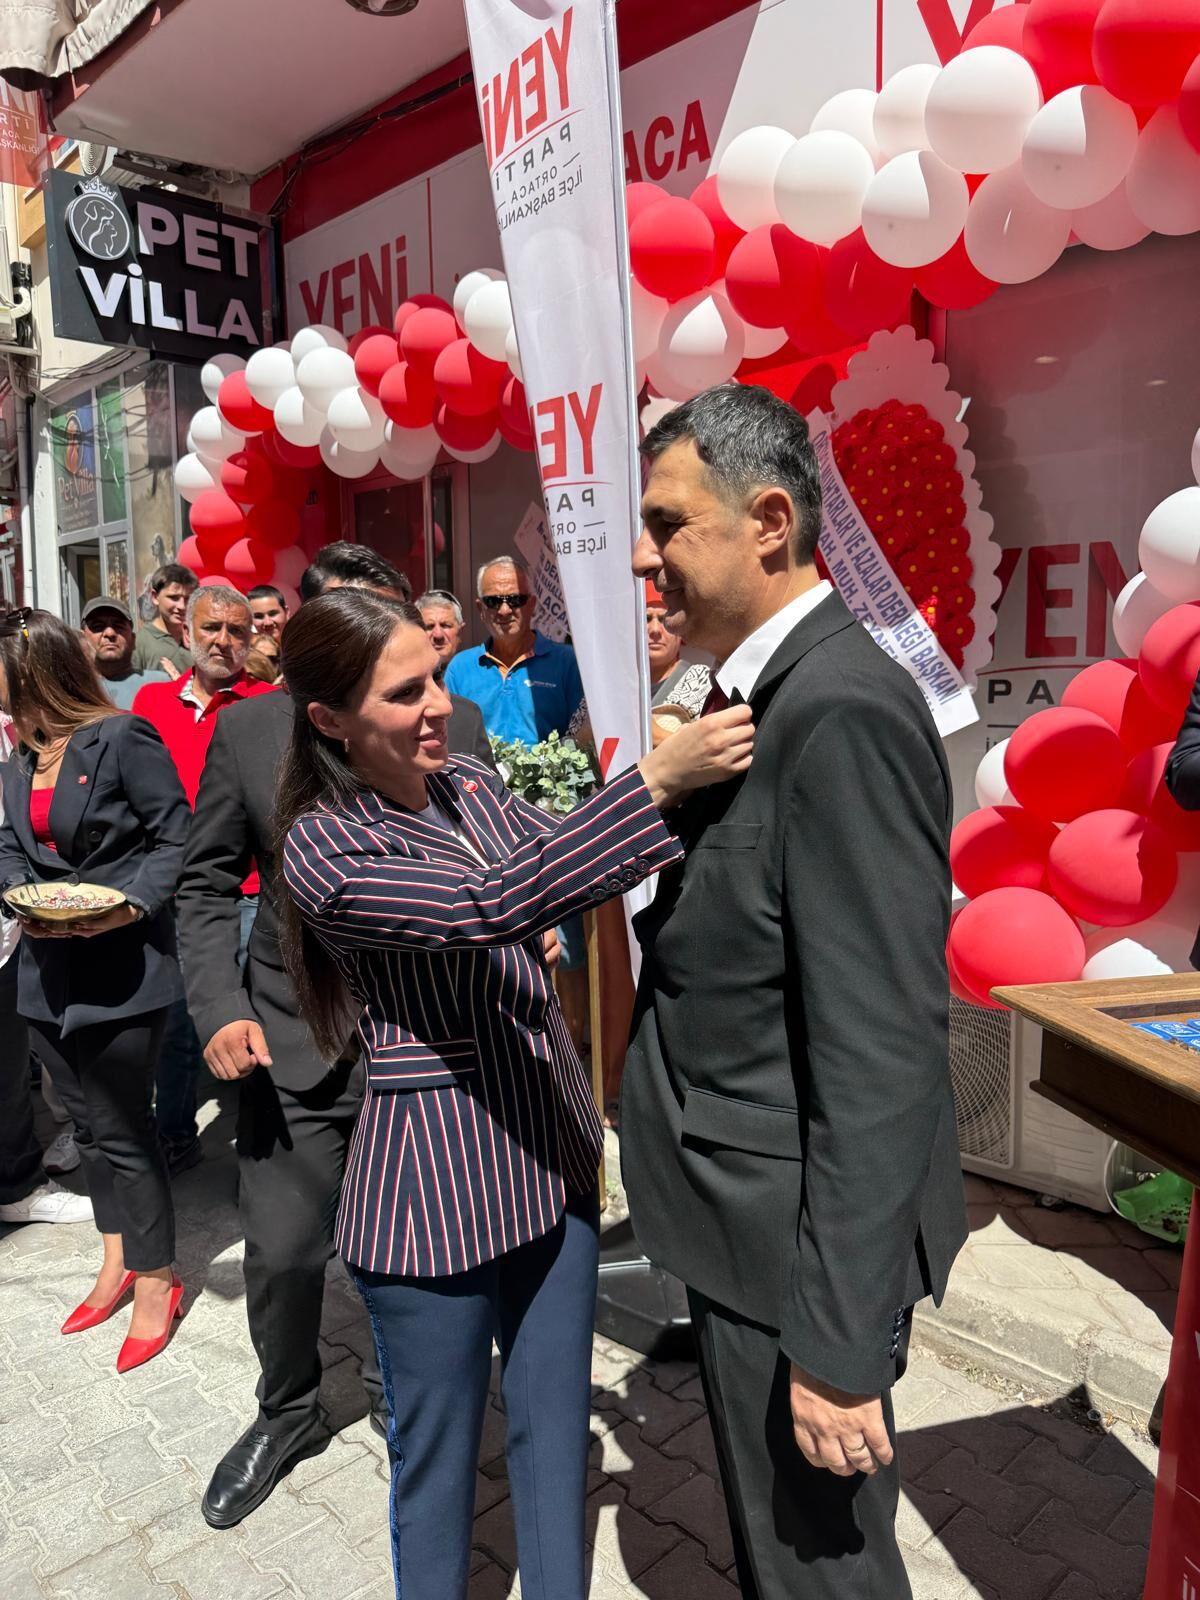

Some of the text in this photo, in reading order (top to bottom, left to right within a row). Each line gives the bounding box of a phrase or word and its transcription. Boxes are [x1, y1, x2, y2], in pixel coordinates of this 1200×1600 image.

[137, 201, 259, 278] PET
[843, 527, 867, 556] VE
[831, 557, 859, 605] MUH.
[850, 545, 893, 601] AZALAR
